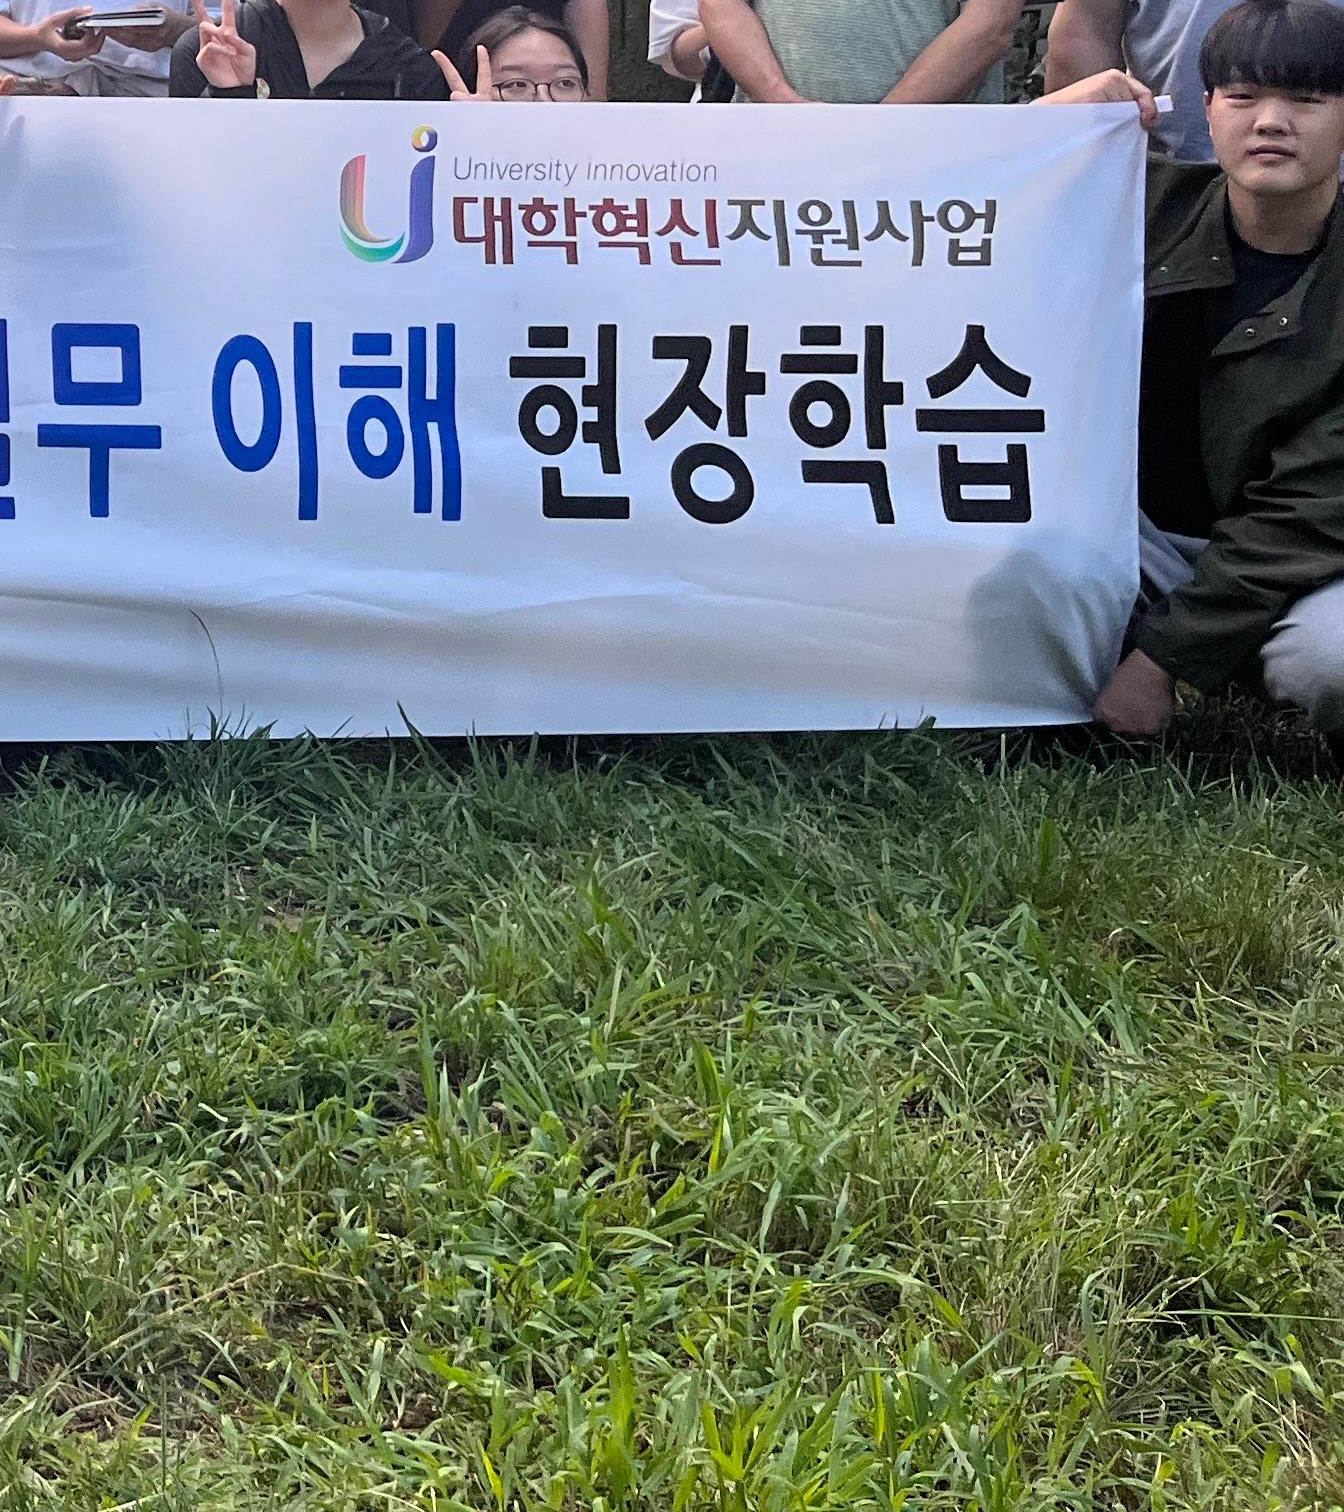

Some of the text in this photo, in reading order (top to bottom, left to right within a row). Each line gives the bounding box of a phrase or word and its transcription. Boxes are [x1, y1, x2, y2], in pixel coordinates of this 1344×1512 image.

[453, 156, 717, 187] University innovation
[451, 195, 998, 267] 대학혁신지원사업
[211, 321, 463, 522] 이해
[508, 323, 1046, 525] 현장학습
